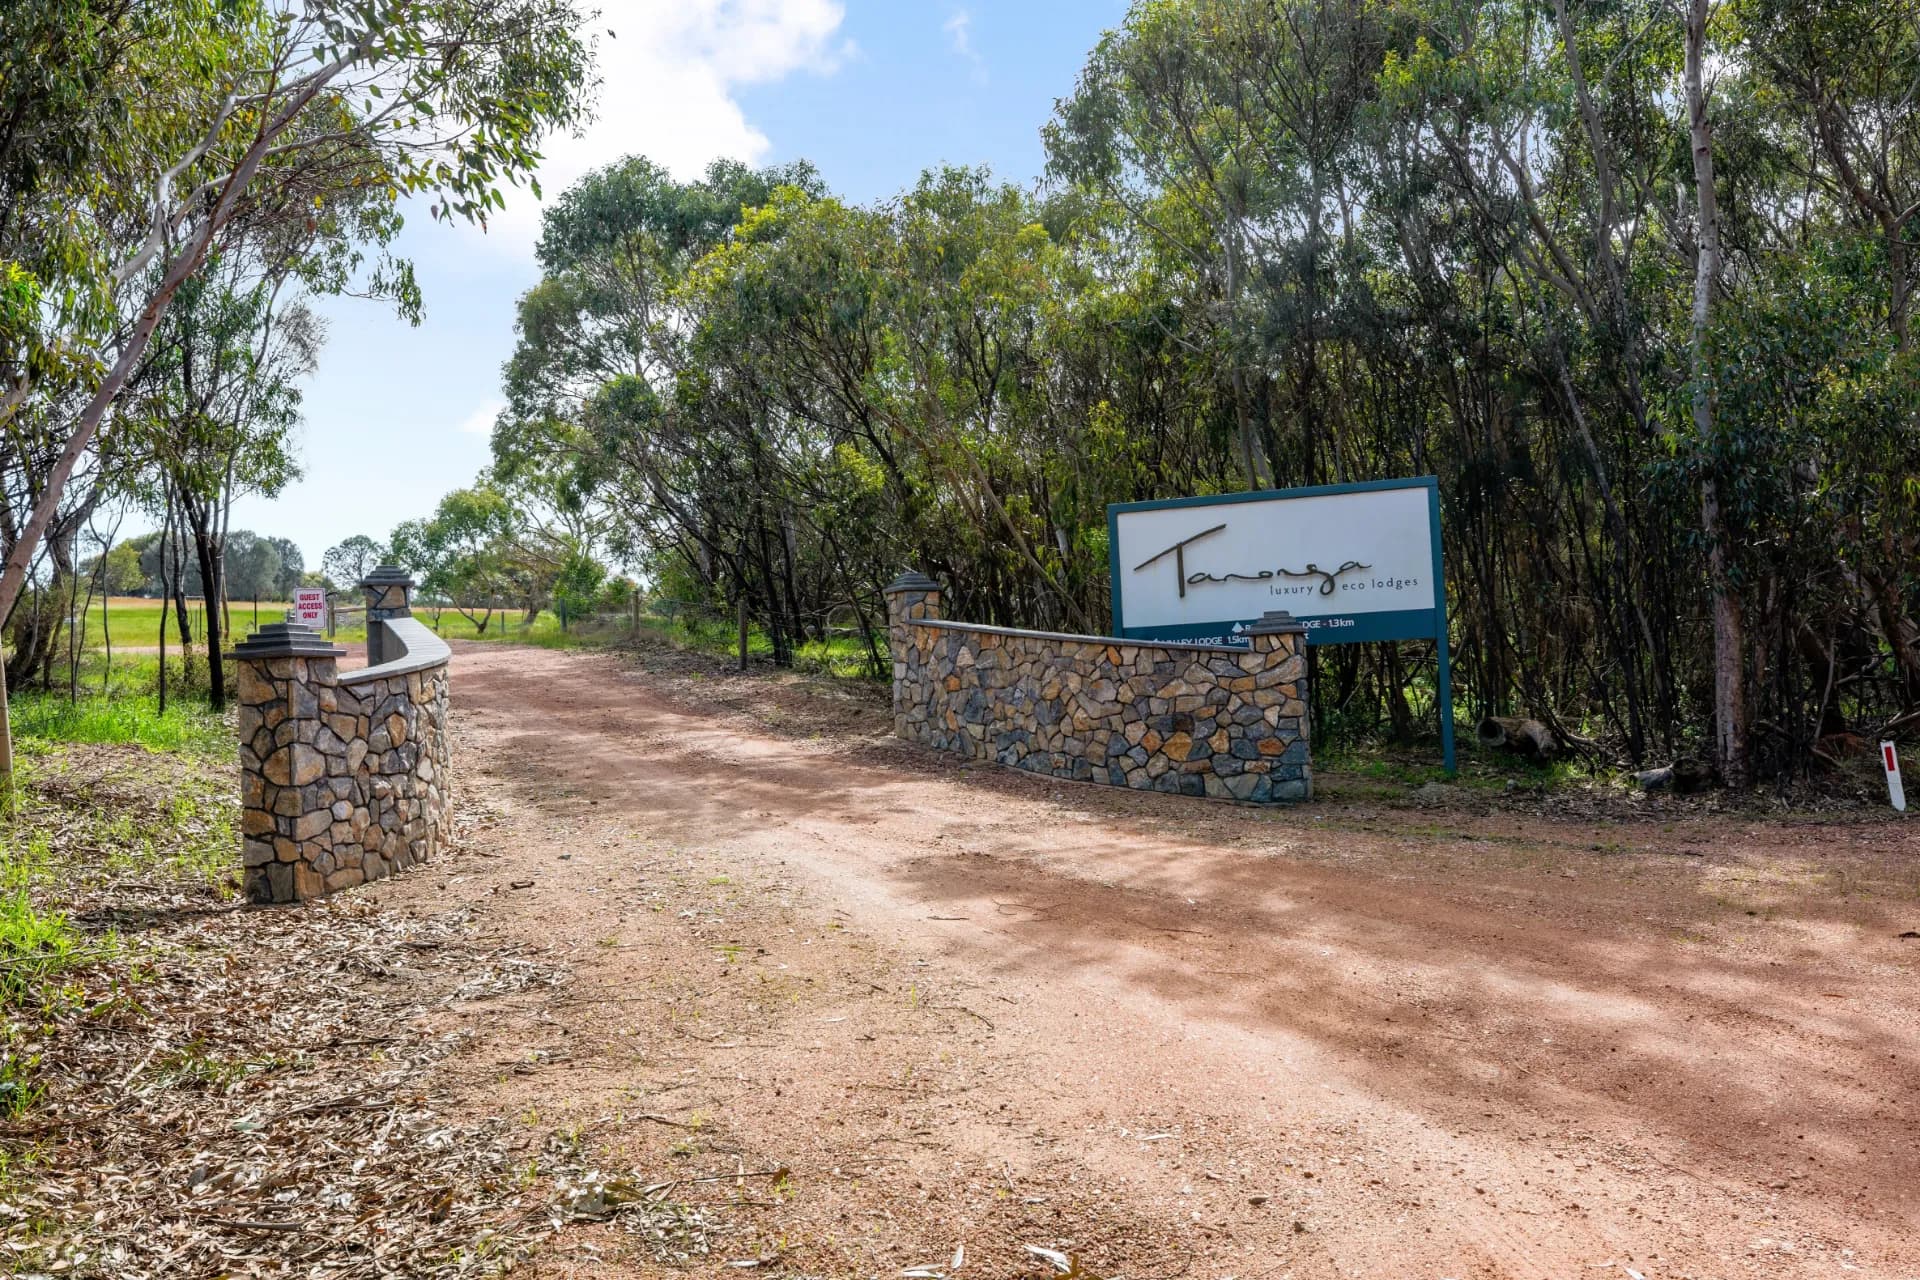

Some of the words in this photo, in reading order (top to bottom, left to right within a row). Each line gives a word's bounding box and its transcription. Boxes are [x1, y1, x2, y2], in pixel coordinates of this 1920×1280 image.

[1133, 523, 1372, 598] Tanonga
[1269, 585, 1314, 595] luxury
[1342, 582, 1365, 590] eco
[1371, 577, 1418, 590] lodges
[299, 593, 320, 601] GUEST
[298, 602, 322, 610] ACCESS
[1302, 620, 1321, 629] DGE
[1195, 636, 1223, 646] LODGE
